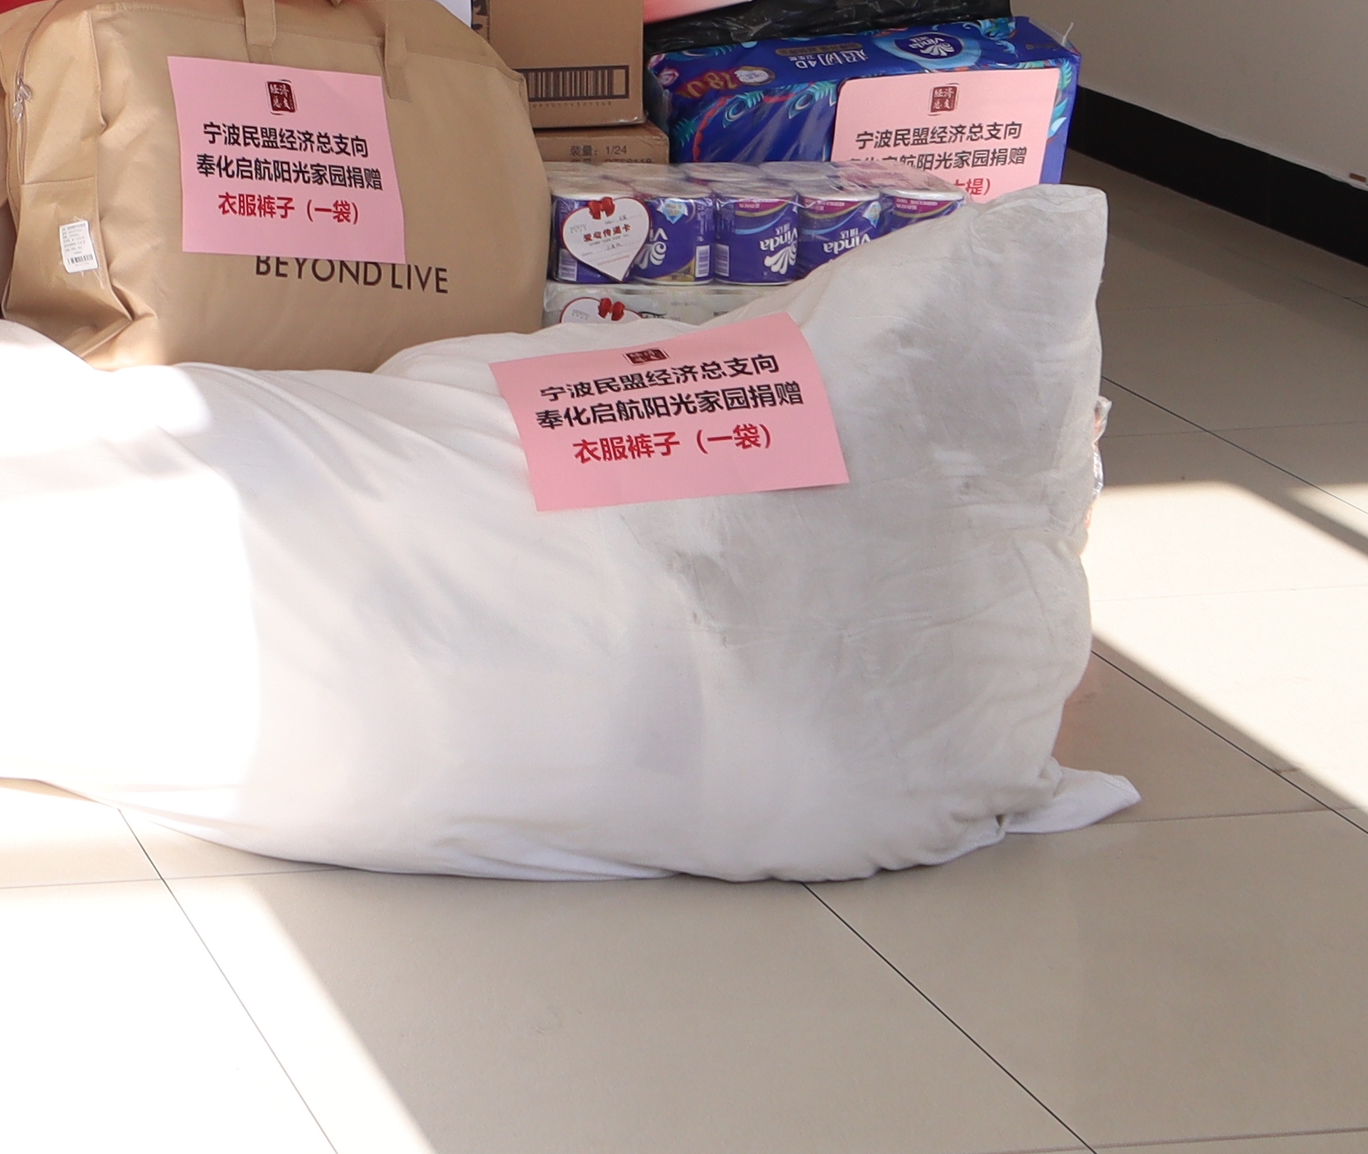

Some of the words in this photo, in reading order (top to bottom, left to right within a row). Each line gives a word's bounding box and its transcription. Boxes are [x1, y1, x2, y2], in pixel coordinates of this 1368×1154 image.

[203, 122, 369, 158] 宁波民盟经济总支向
[855, 121, 1022, 149] 宁波民盟经济总支向
[196, 154, 383, 191] 奉化启航阳光家园捐赠
[218, 192, 359, 225] 衣服裤子（一袋）
[255, 255, 382, 286] BEYOND
[391, 263, 449, 294] LIVE
[540, 353, 780, 402] 宁波民盟经济总支向
[535, 380, 804, 430] 奉化启航阳光家园捐赠
[572, 423, 774, 465] 衣服裤子（一袋）
